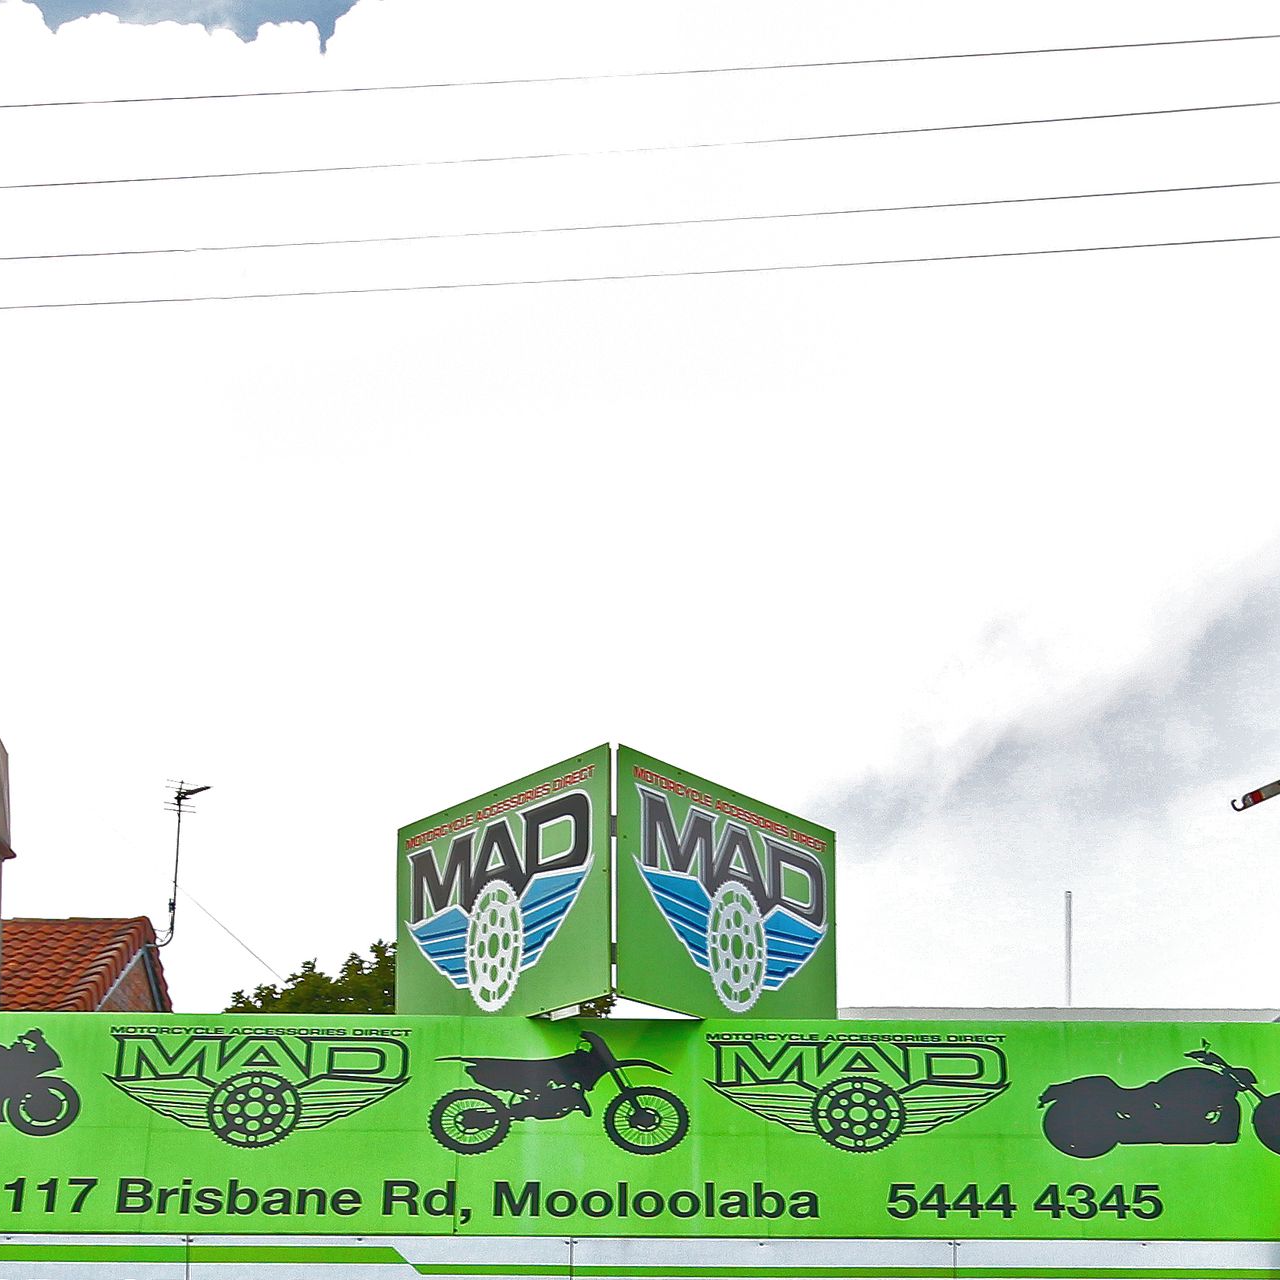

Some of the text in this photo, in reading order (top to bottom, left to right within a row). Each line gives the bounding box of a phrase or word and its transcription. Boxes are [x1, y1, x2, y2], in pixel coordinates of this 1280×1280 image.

[406, 764, 595, 849] MOTORCYCLE ACCESSORIES DIRECT
[632, 764, 827, 853] MOTORCYCLE ACCESSORIES DIRECT
[407, 789, 593, 927] MAD
[635, 783, 827, 928] MAD
[110, 1026, 413, 1037] MOTORCYCLE ACCESSORIES DIRECT
[705, 1033, 1007, 1043] MOTORCYCLE ACCESSORIES DIRECT
[111, 1035, 410, 1083] MAD
[707, 1041, 1008, 1089] MAD
[3, 1178, 1164, 1224] 117 Brisbane Rd, Mooloolaba 5444 4345
